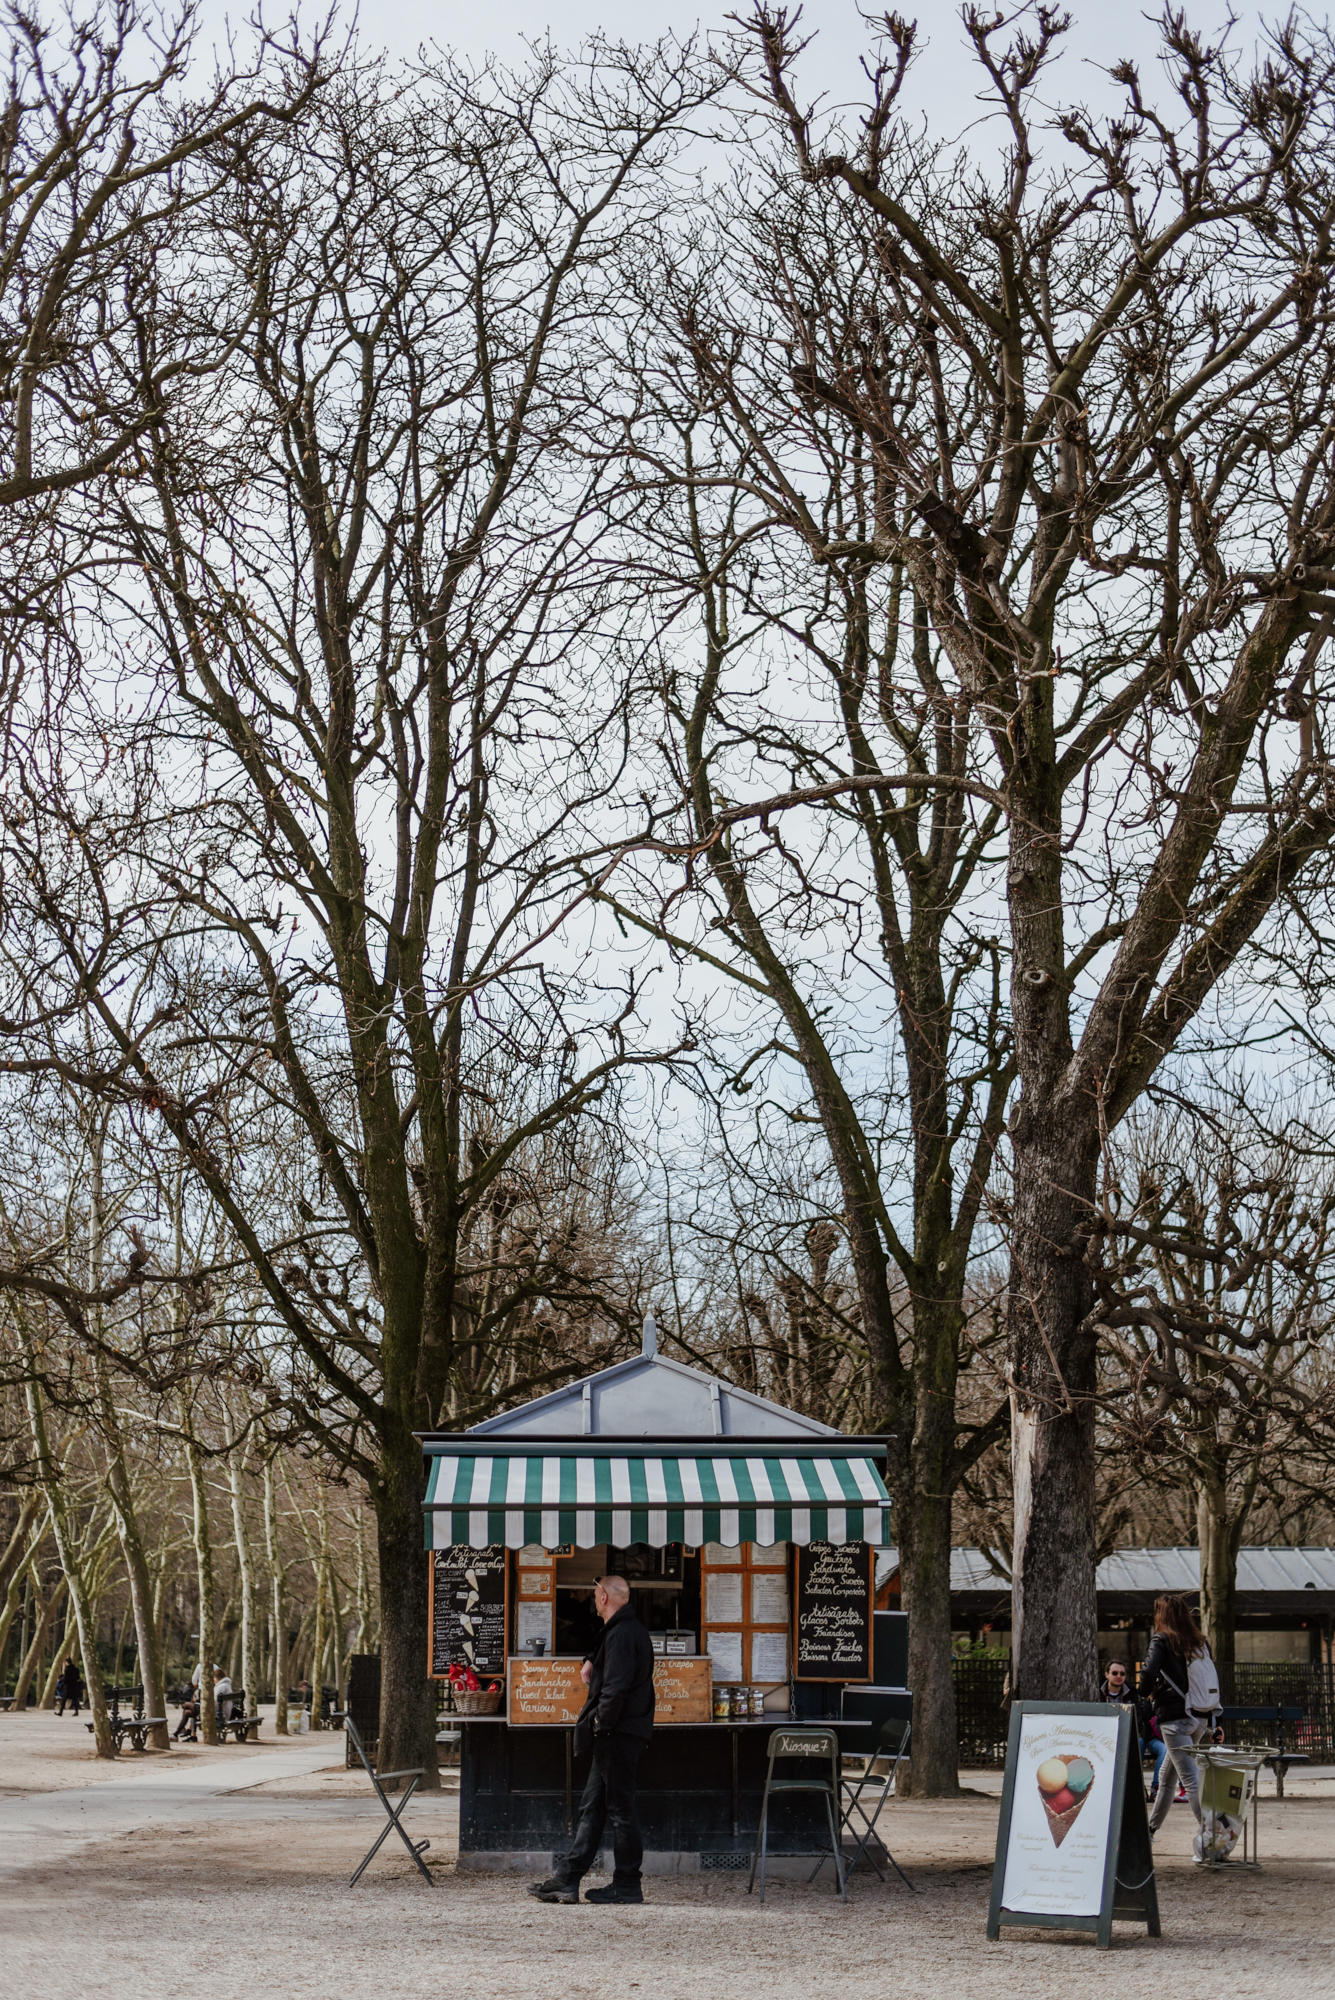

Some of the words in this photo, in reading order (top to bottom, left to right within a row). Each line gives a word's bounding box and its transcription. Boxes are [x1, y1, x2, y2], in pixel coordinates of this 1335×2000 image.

[520, 1700, 556, 1713] Various
[780, 1736, 820, 1757] Kiosque
[820, 1738, 829, 1752] 7
